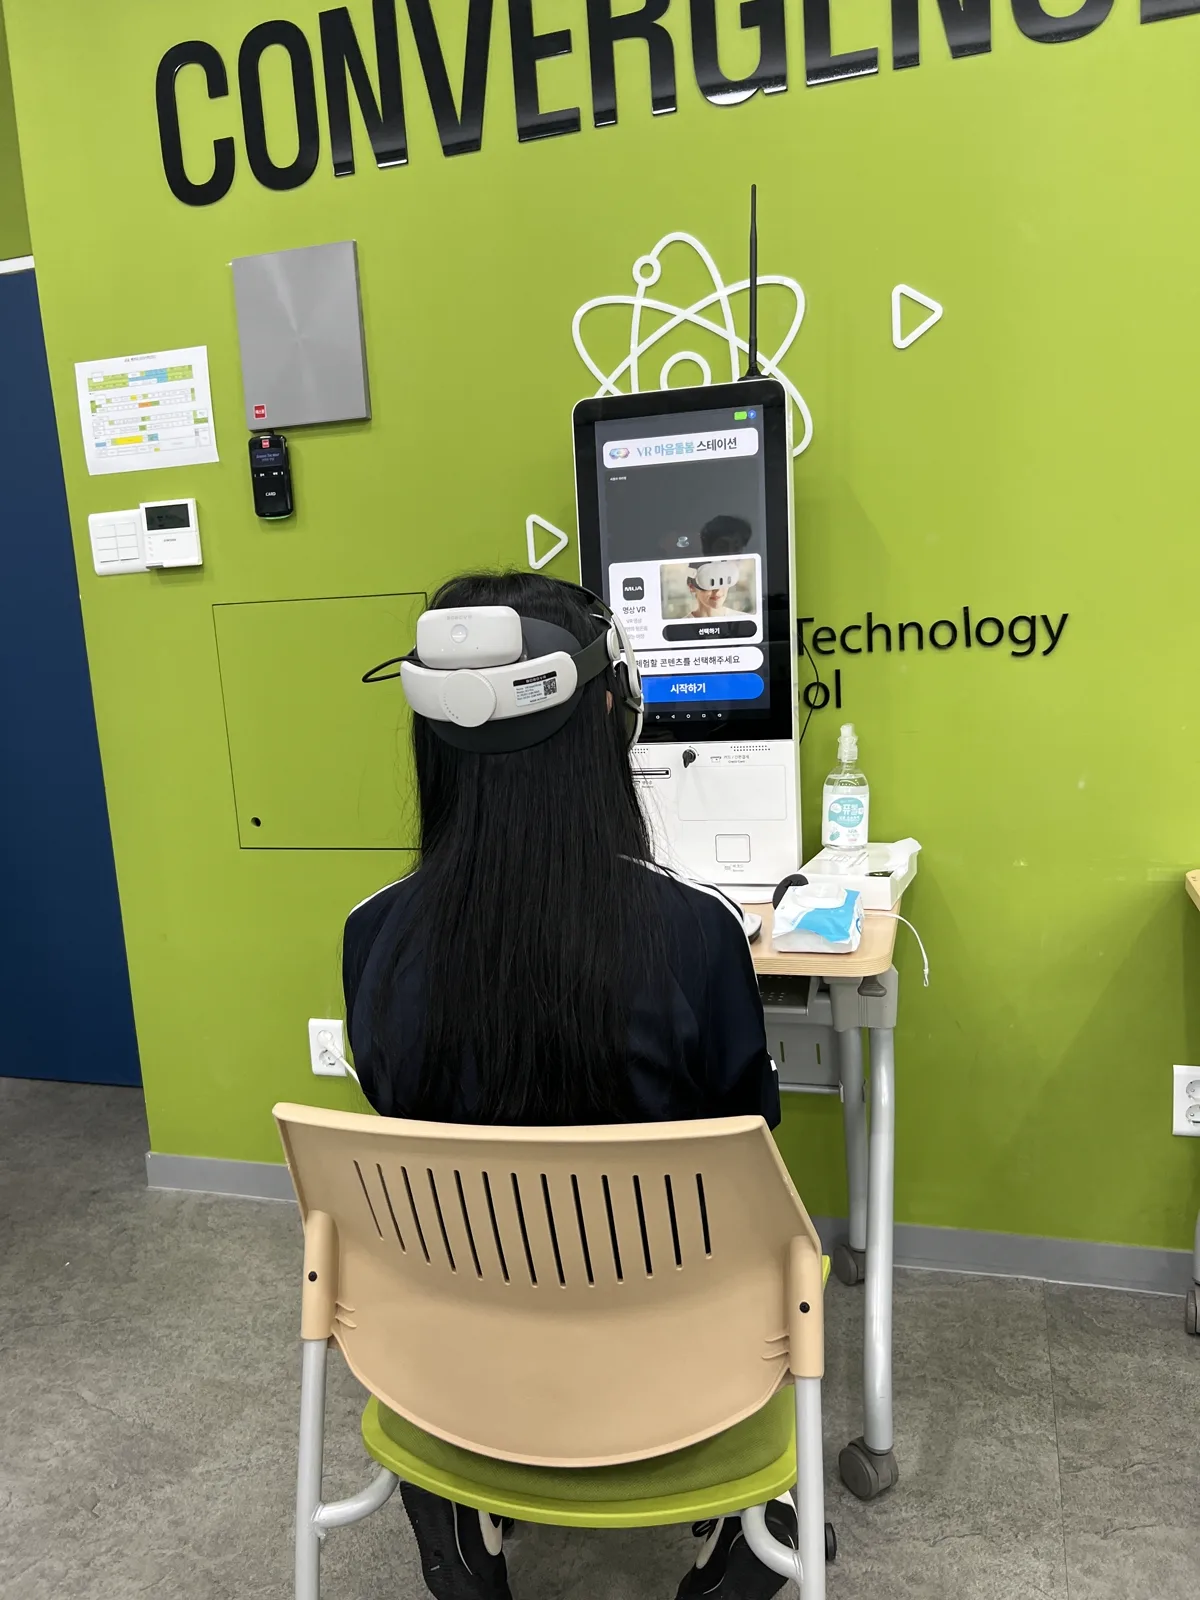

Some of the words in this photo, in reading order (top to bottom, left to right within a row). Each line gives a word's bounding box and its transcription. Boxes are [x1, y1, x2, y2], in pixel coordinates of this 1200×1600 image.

[155, 0, 1200, 205] CONVERG
[636, 446, 652, 457] VR
[654, 441, 695, 457] 마음돌봄
[696, 436, 738, 452] 스테이션
[622, 606, 635, 615] 영상
[698, 627, 720, 636] 선택하기
[796, 606, 1069, 657] Technology
[660, 657, 691, 668] 콘텐츠를
[693, 655, 740, 666] 선택해주세요
[670, 682, 706, 694] 시작하기
[798, 669, 842, 710] ol
